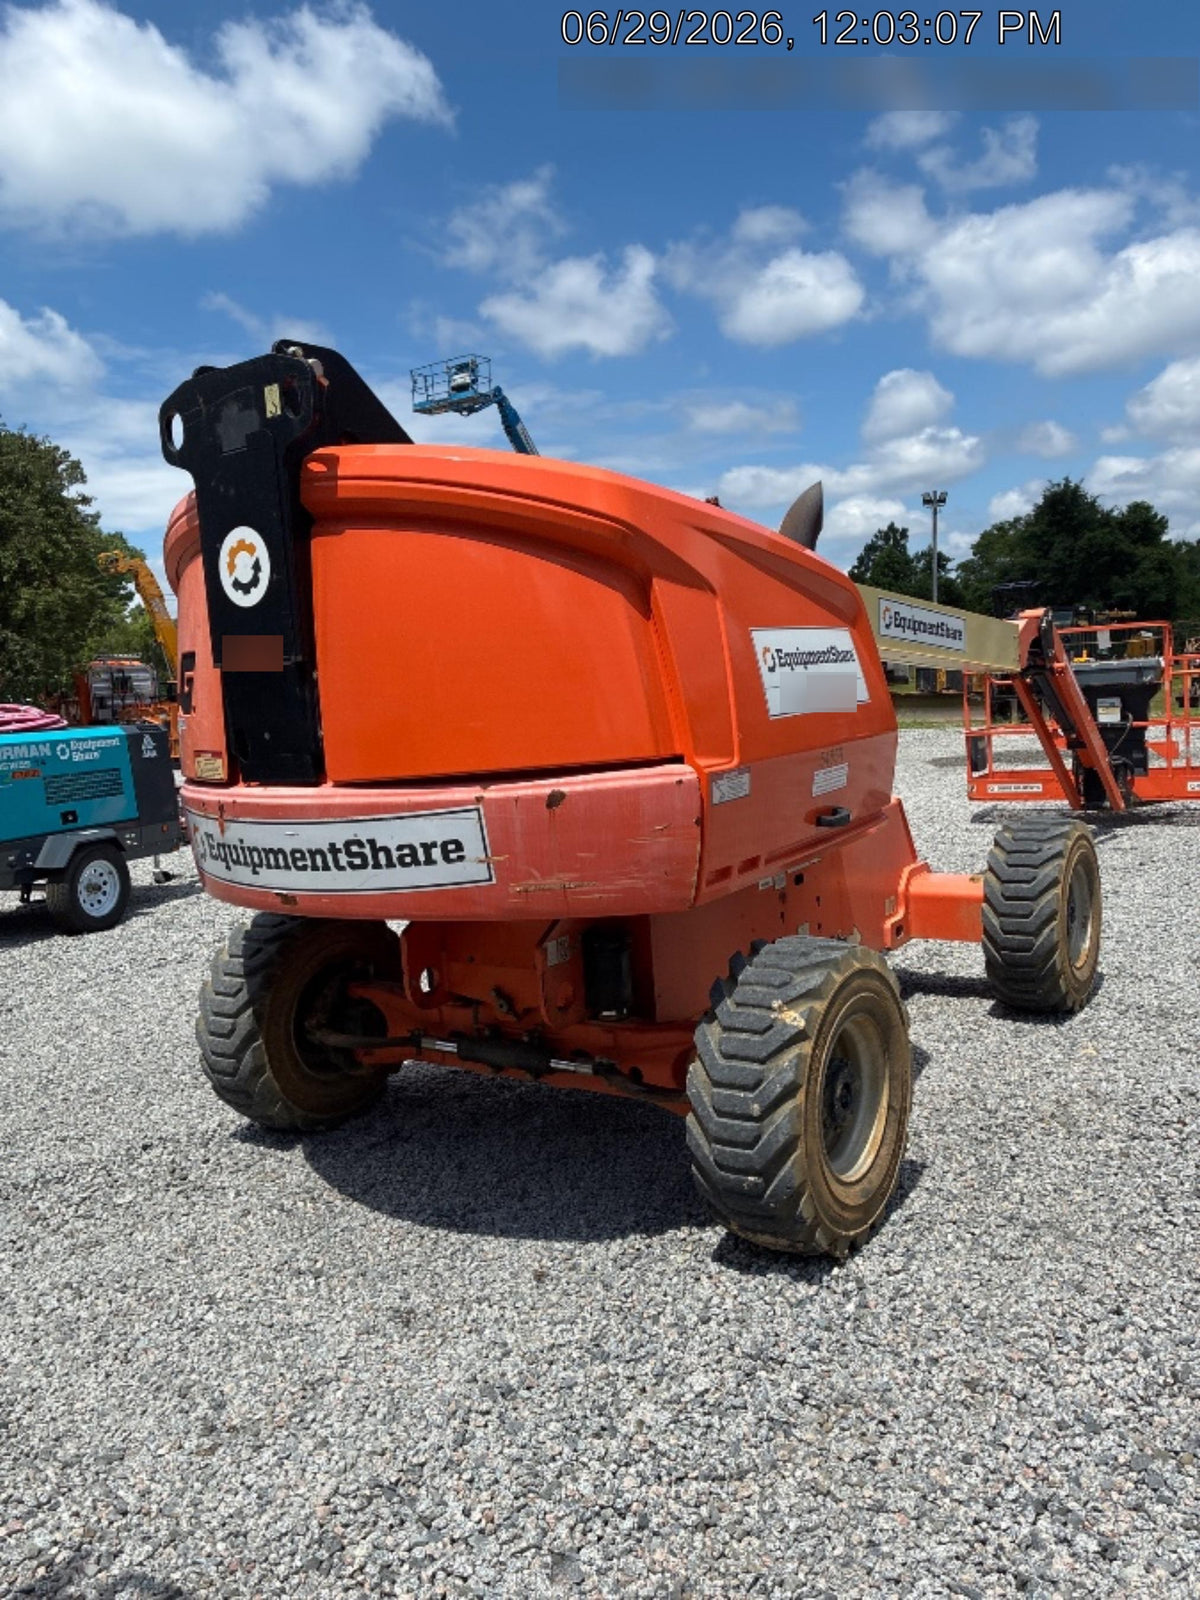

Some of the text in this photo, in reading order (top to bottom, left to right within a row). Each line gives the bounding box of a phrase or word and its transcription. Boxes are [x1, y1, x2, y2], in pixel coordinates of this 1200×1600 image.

[893, 610, 963, 642] EquipmentShare
[774, 645, 856, 671] EquipmentShare
[205, 832, 467, 876] EquipmentShare
